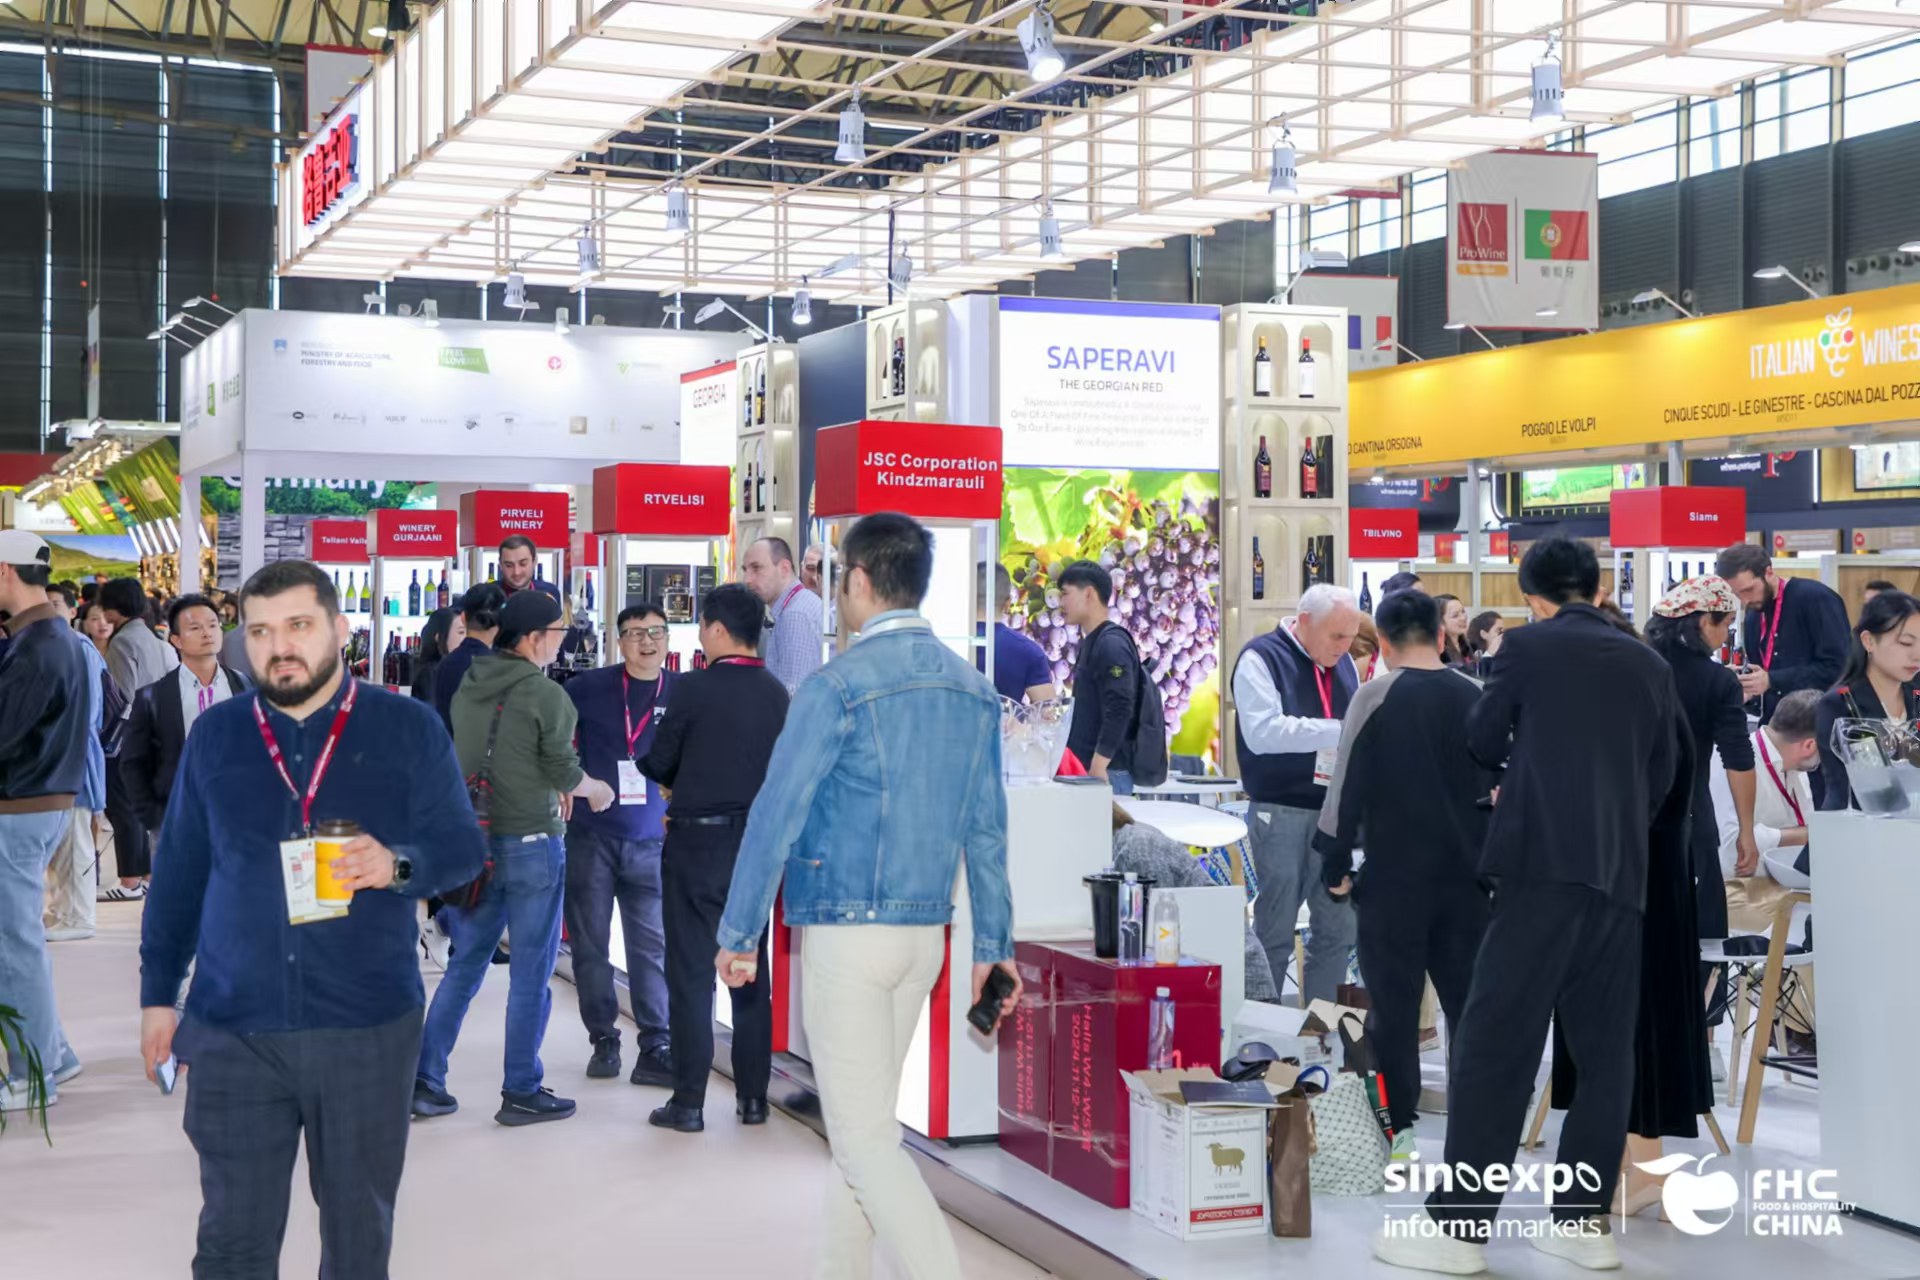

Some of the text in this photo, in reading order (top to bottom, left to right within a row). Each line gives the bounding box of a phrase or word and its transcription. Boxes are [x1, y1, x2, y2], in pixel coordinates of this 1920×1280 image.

[1459, 246, 1506, 260] ProWine
[301, 350, 333, 358] MINISTRY
[1750, 323, 1920, 380] ITALIAN WINES
[301, 358, 336, 366] FORESTRY
[1047, 345, 1175, 373] SAPERAVI
[1059, 378, 1164, 393] THE GEORGIAN RED
[693, 383, 727, 409] GEORGIA
[1663, 406, 1700, 424] CINQUE
[1700, 403, 1731, 420] SCUDI
[1739, 400, 1751, 416] LE
[1753, 394, 1805, 415] GINESTRE
[1814, 389, 1864, 409] CASCINA
[1866, 386, 1889, 403] DAL
[1521, 416, 1596, 438] POGGIO LE VOLPI
[1353, 440, 1385, 455] CANTINA
[1385, 436, 1423, 451] ORSOGNA
[863, 452, 998, 474] JSC Corporation
[877, 472, 985, 490] Kindzmarauli
[644, 493, 705, 506] RTVELISI
[500, 508, 544, 519] PIRVELI
[1689, 512, 1719, 522] Siame
[399, 524, 437, 532] WINERY
[500, 520, 544, 529] WINERY
[393, 533, 442, 542] GURJAANI
[1363, 528, 1403, 538] TBILVINO
[1083, 1004, 1093, 1053] Halls
